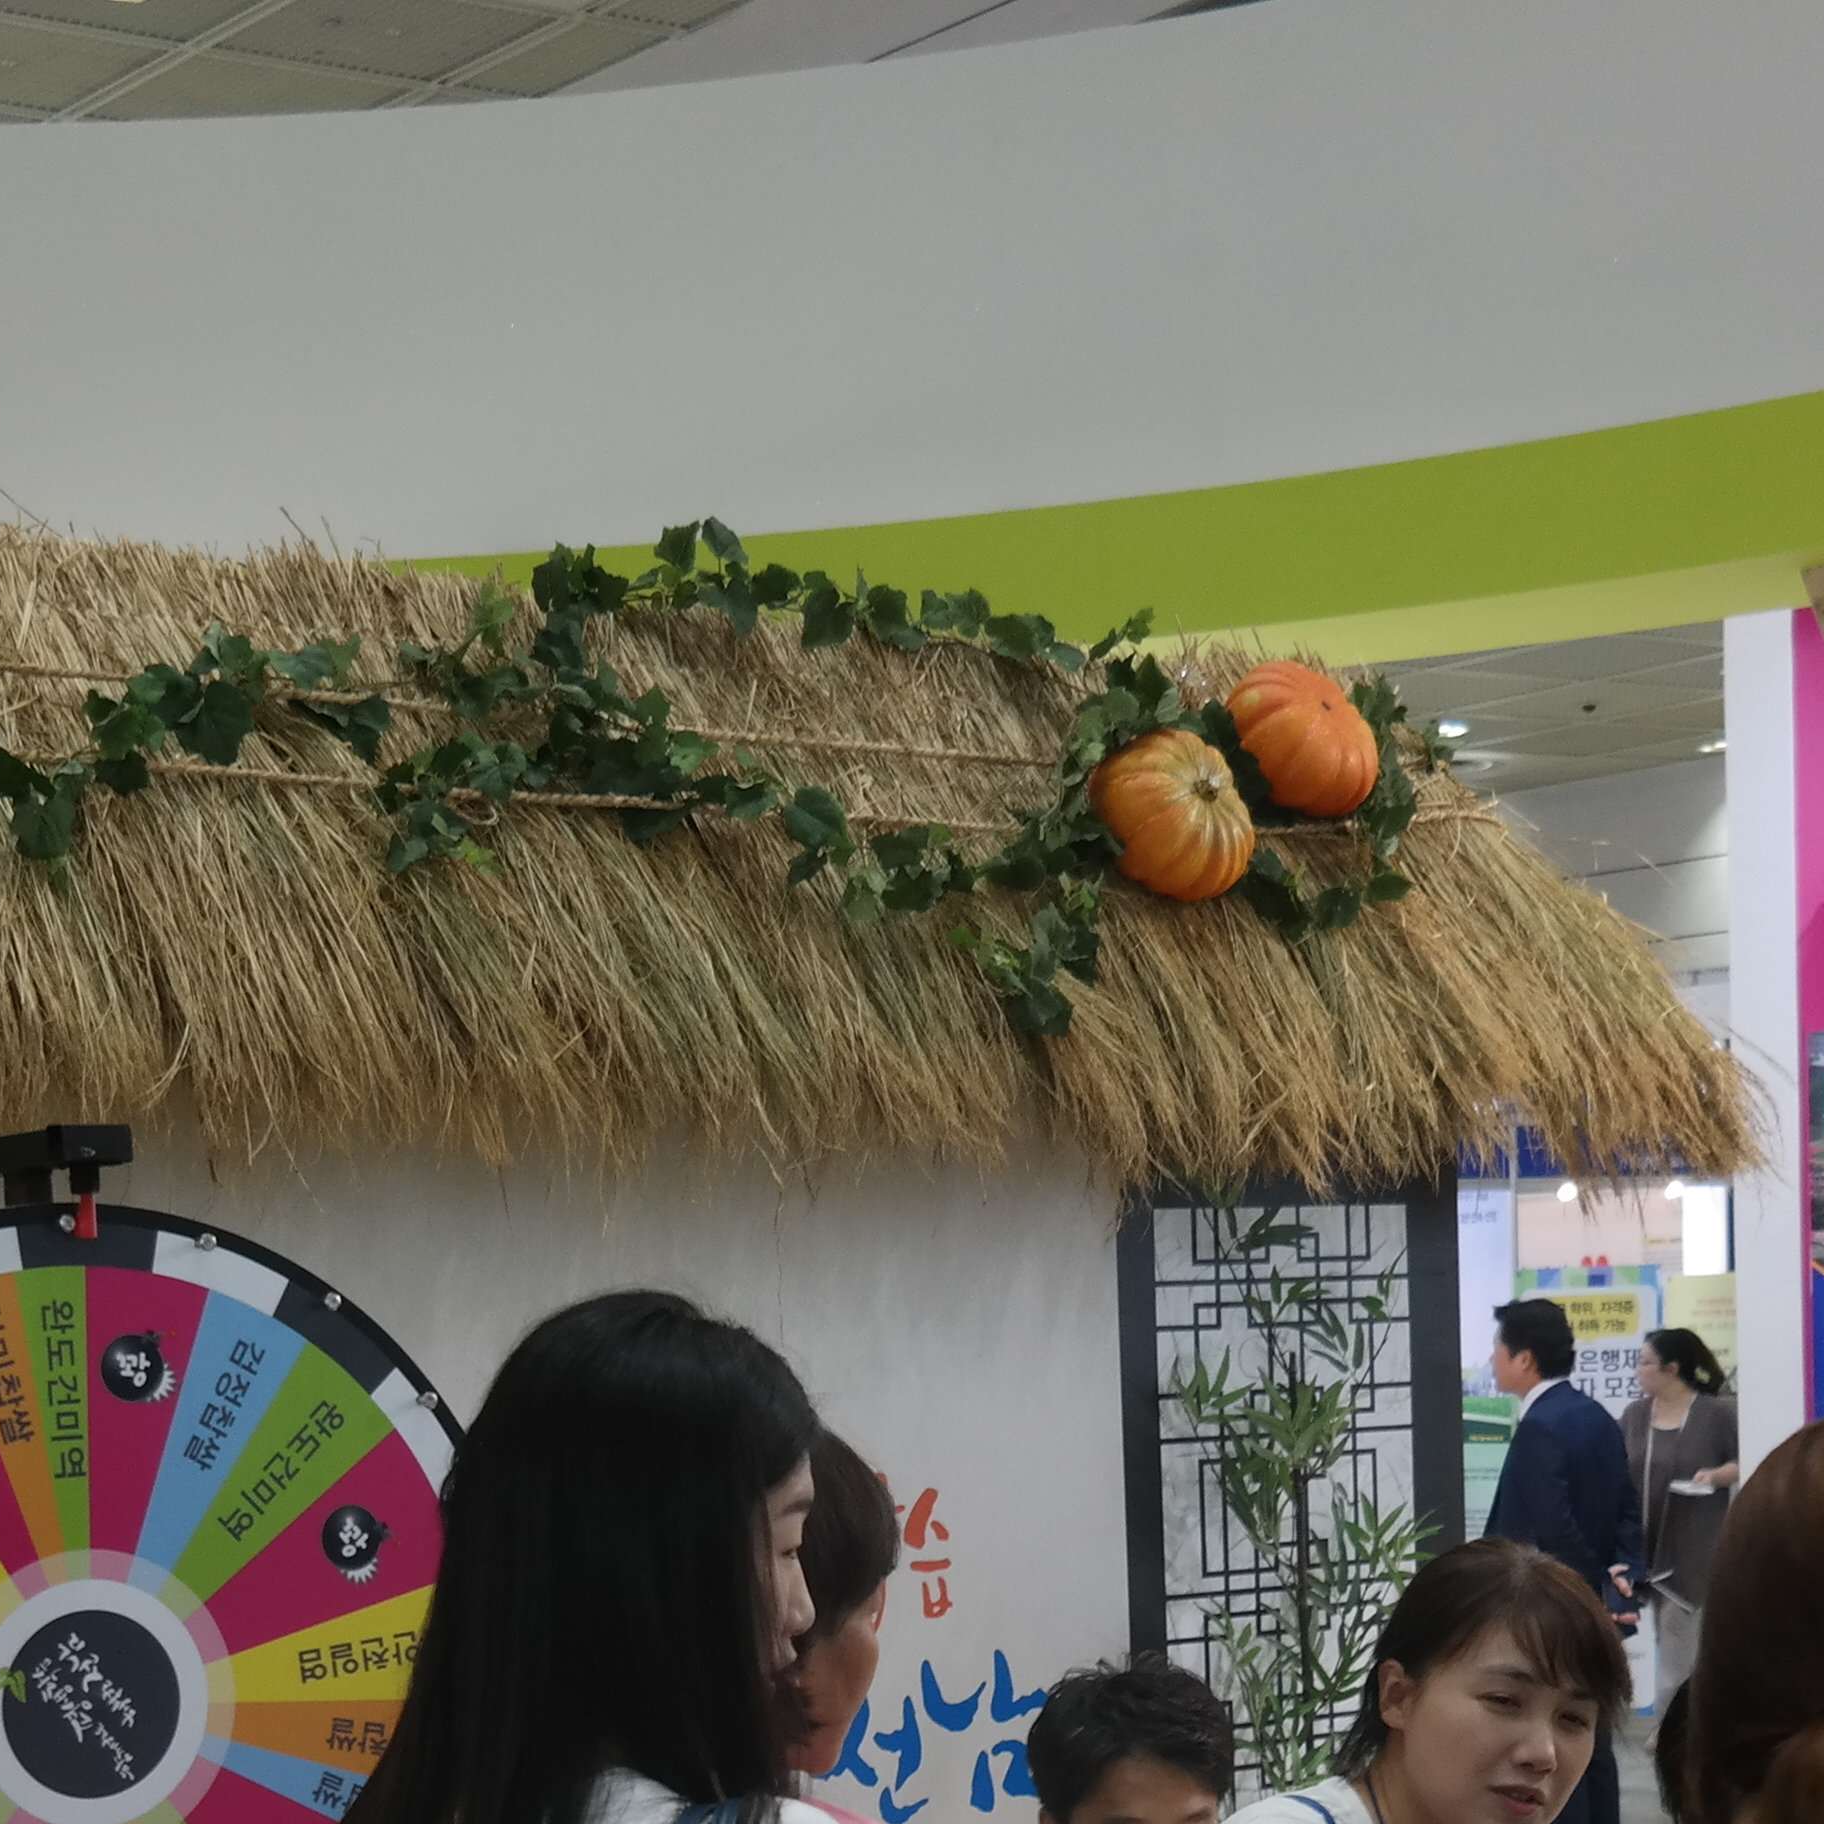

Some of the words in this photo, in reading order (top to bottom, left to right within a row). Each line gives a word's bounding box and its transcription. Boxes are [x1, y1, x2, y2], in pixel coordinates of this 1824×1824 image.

[183, 1337, 268, 1473] 검정찹쌀
[297, 1630, 422, 1685] 안천일염
[325, 1716, 388, 1757] 찹쌀
